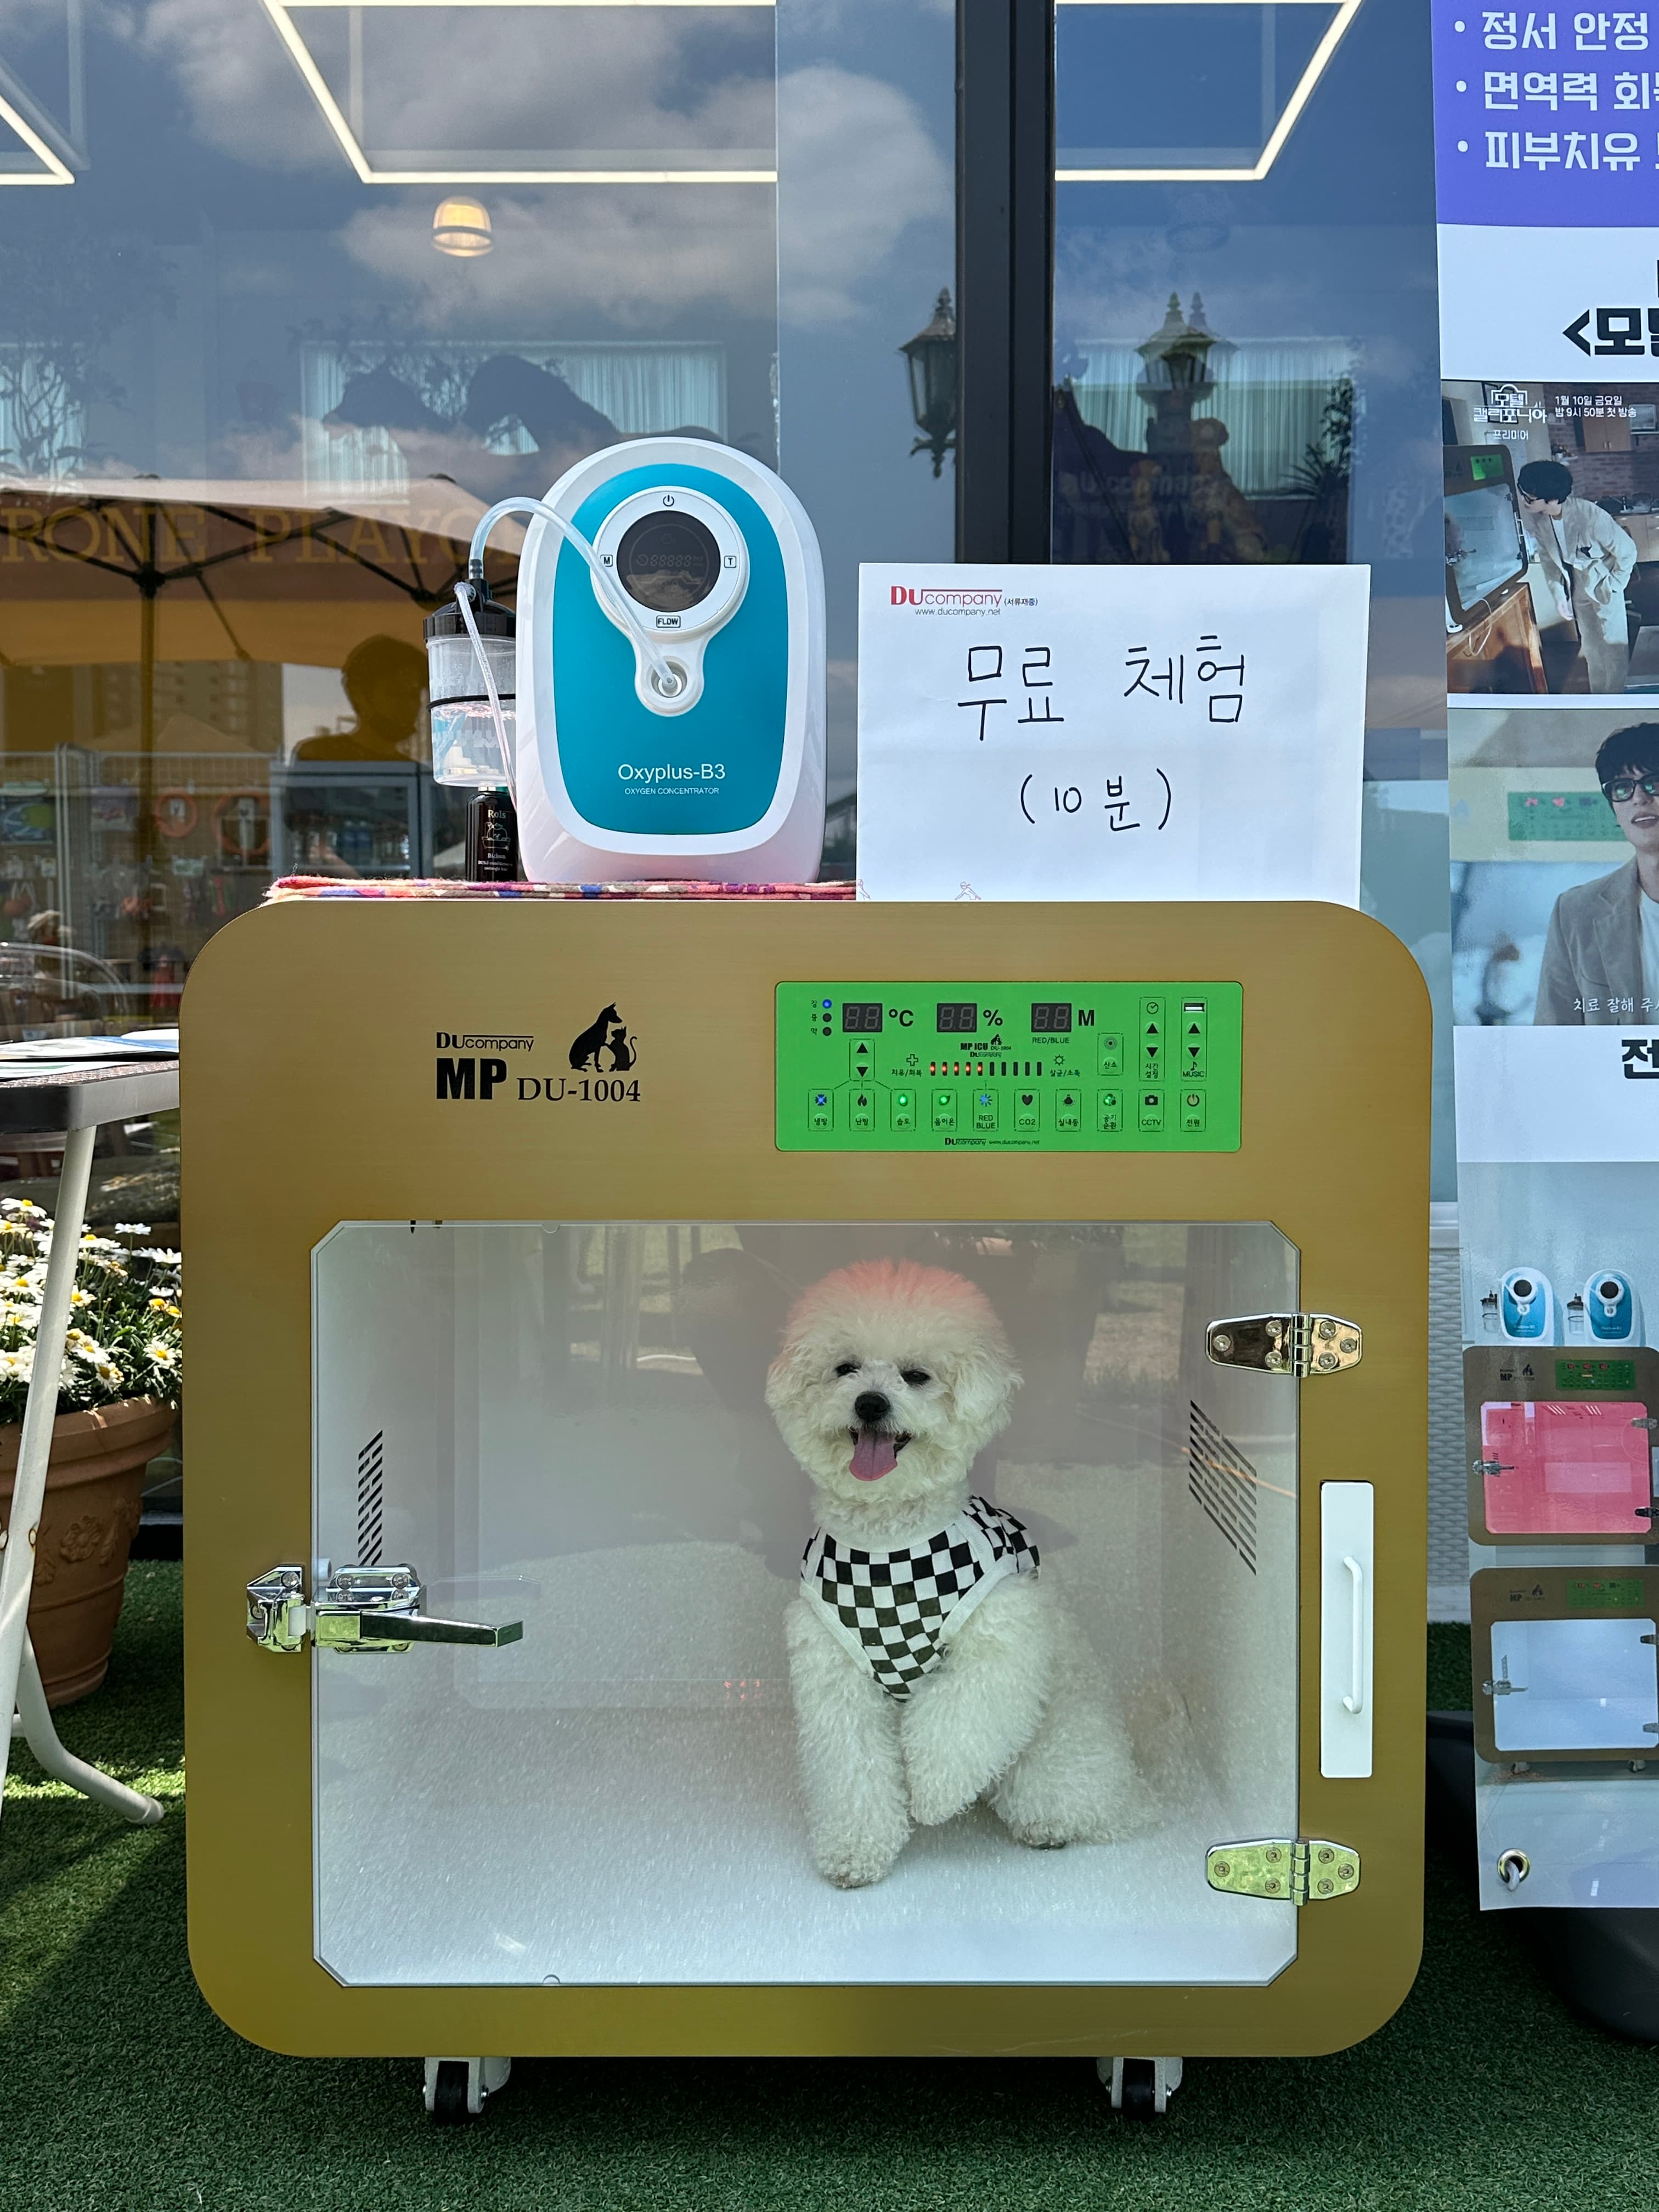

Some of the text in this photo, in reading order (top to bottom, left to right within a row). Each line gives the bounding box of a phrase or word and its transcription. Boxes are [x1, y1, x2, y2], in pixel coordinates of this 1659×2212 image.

[1482, 12, 1649, 50] 정서 안정
[1484, 71, 1659, 111] 면역력 회
[1485, 132, 1640, 171] 피부치유
[1562, 308, 1659, 357] <모
[1495, 393, 1524, 407] 모텔
[1555, 396, 1622, 406] 1월 10일 금요일
[1474, 408, 1547, 424] 캘리포니아
[1555, 408, 1637, 418] 밤 9시 50분 첫 방송
[1493, 430, 1529, 440] 프리미어
[891, 585, 1003, 608] DUcompany
[915, 607, 1001, 616] www.ducompany.net
[957, 635, 1244, 741] 무료 체험
[618, 763, 726, 784] Oxyplus-B3
[487, 809, 507, 819] Rols
[1573, 997, 1659, 1013] 치료 잘해 주
[983, 1009, 1003, 1026] %
[1078, 1009, 1094, 1026] M
[436, 1032, 534, 1052] DUcompany
[1032, 1036, 1070, 1045] RED/BLUE
[1103, 1060, 1118, 1069] 산소
[437, 1058, 641, 1102] MP DU-1004
[1186, 1118, 1200, 1127] 전원
